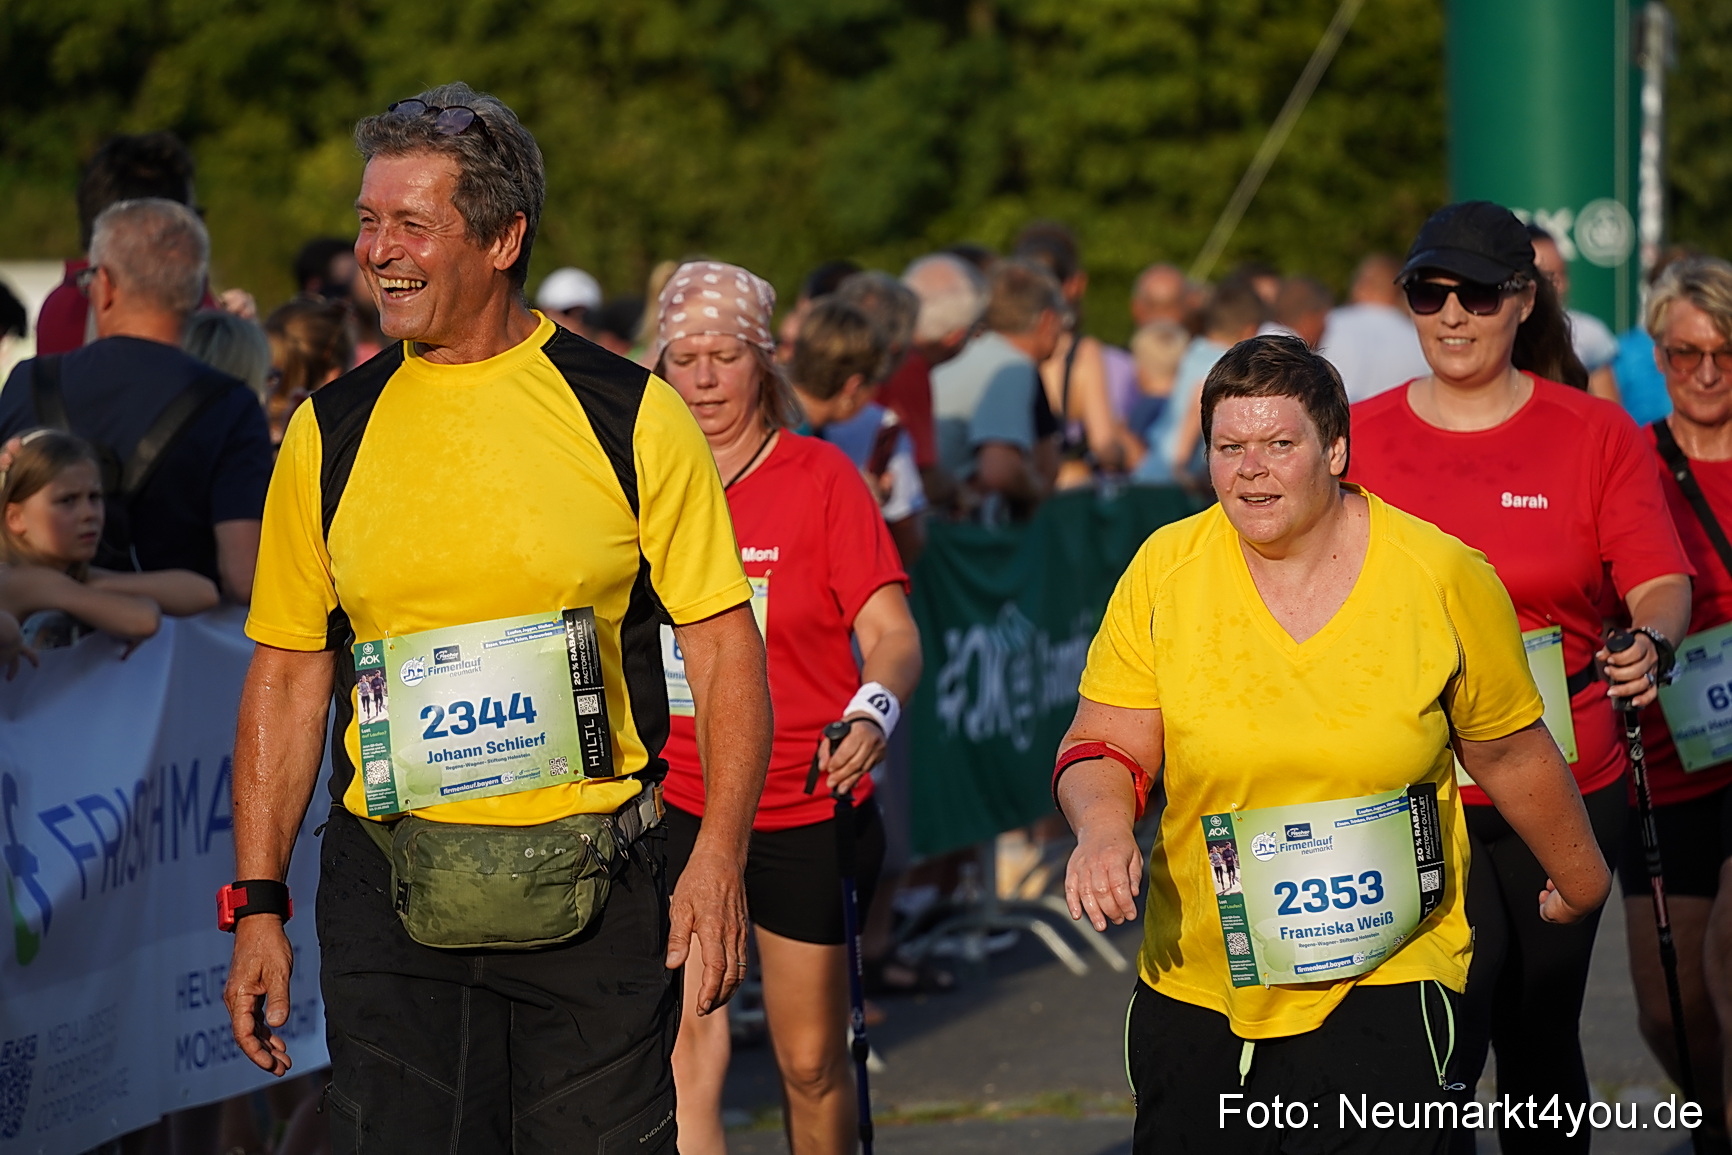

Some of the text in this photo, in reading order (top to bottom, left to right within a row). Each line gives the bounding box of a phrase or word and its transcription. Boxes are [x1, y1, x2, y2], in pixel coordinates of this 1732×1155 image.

[1501, 491, 1548, 509] Sarah
[741, 546, 779, 562] Moni
[576, 620, 585, 650] OUTLET
[359, 654, 381, 666] AOK
[566, 620, 581, 685] 20 % RABATT
[427, 657, 482, 676] Firmenlauf
[449, 666, 482, 678] neumarkt
[580, 651, 589, 684] FACTORY
[420, 692, 537, 740] 2344
[426, 732, 546, 764] Johann Schlierf
[584, 719, 600, 767] HILTL
[443, 778, 499, 795] firmenlauf.bayern
[1410, 796, 1421, 837] RABATT
[1418, 796, 1427, 825] OUTLET
[1208, 826, 1230, 837] AOK
[1279, 835, 1333, 852] Firmenlauf
[1424, 826, 1432, 860] FACTORY
[1301, 844, 1333, 855] neumarkt
[1417, 847, 1424, 861] 20
[1274, 870, 1384, 916] 2353
[1279, 910, 1394, 940] Franziska Weiß
[1297, 958, 1352, 973] firmenlauf.bayern
